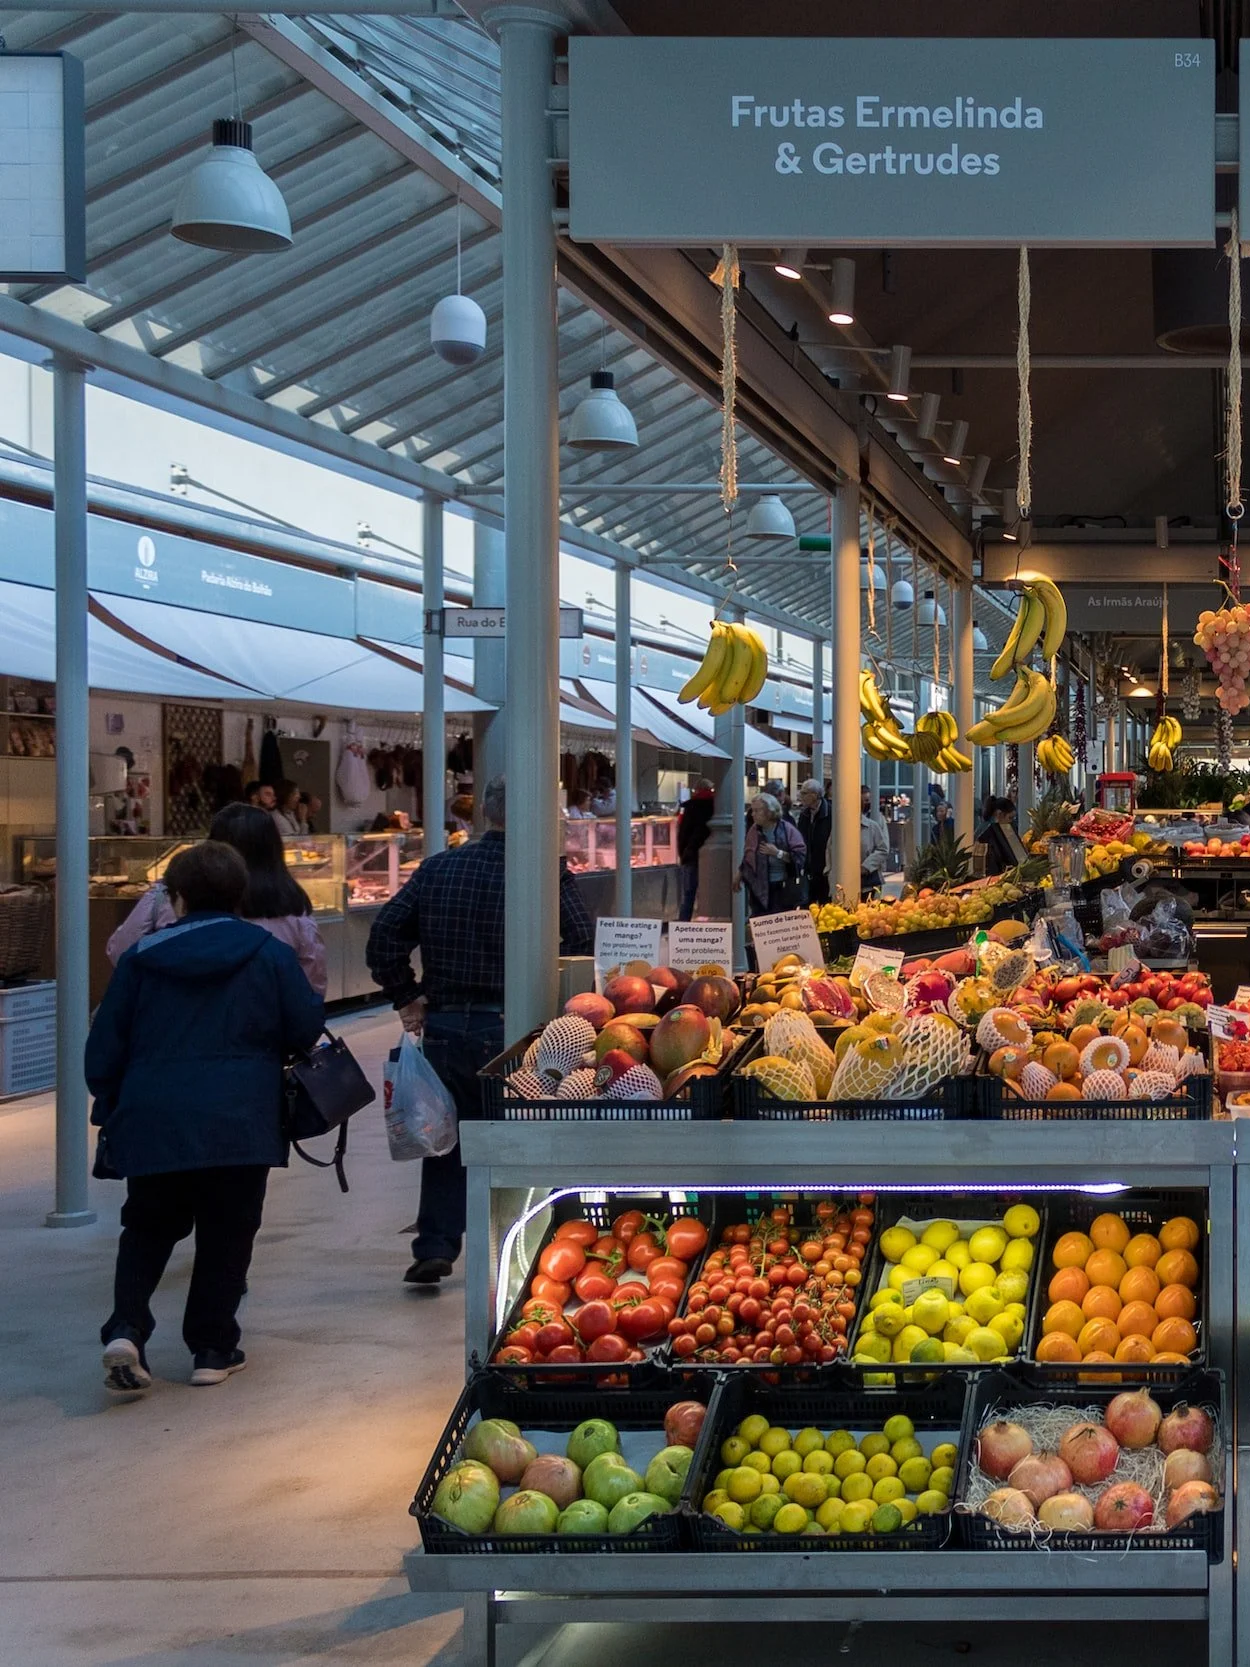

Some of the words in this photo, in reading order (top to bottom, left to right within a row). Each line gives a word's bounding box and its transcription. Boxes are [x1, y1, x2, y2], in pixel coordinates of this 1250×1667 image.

[1174, 54, 1201, 68] B34
[731, 95, 845, 129] Frutas
[855, 95, 1044, 129] Ermelinda
[774, 143, 803, 176] &
[813, 142, 1000, 176] Gertrudes
[1087, 596, 1101, 607] As
[1103, 596, 1133, 607] Irmãs
[457, 616, 479, 628] Rua
[480, 616, 497, 628] do
[600, 920, 615, 928] Feel
[630, 922, 652, 930] eating
[752, 918, 774, 928] Sumo
[774, 916, 784, 924] de
[675, 925, 703, 934] Apetece
[614, 932, 642, 940] mango?
[696, 936, 723, 945] manga?
[612, 942, 638, 950] problem,
[691, 947, 727, 955] problema,
[685, 957, 730, 965] descascamos
